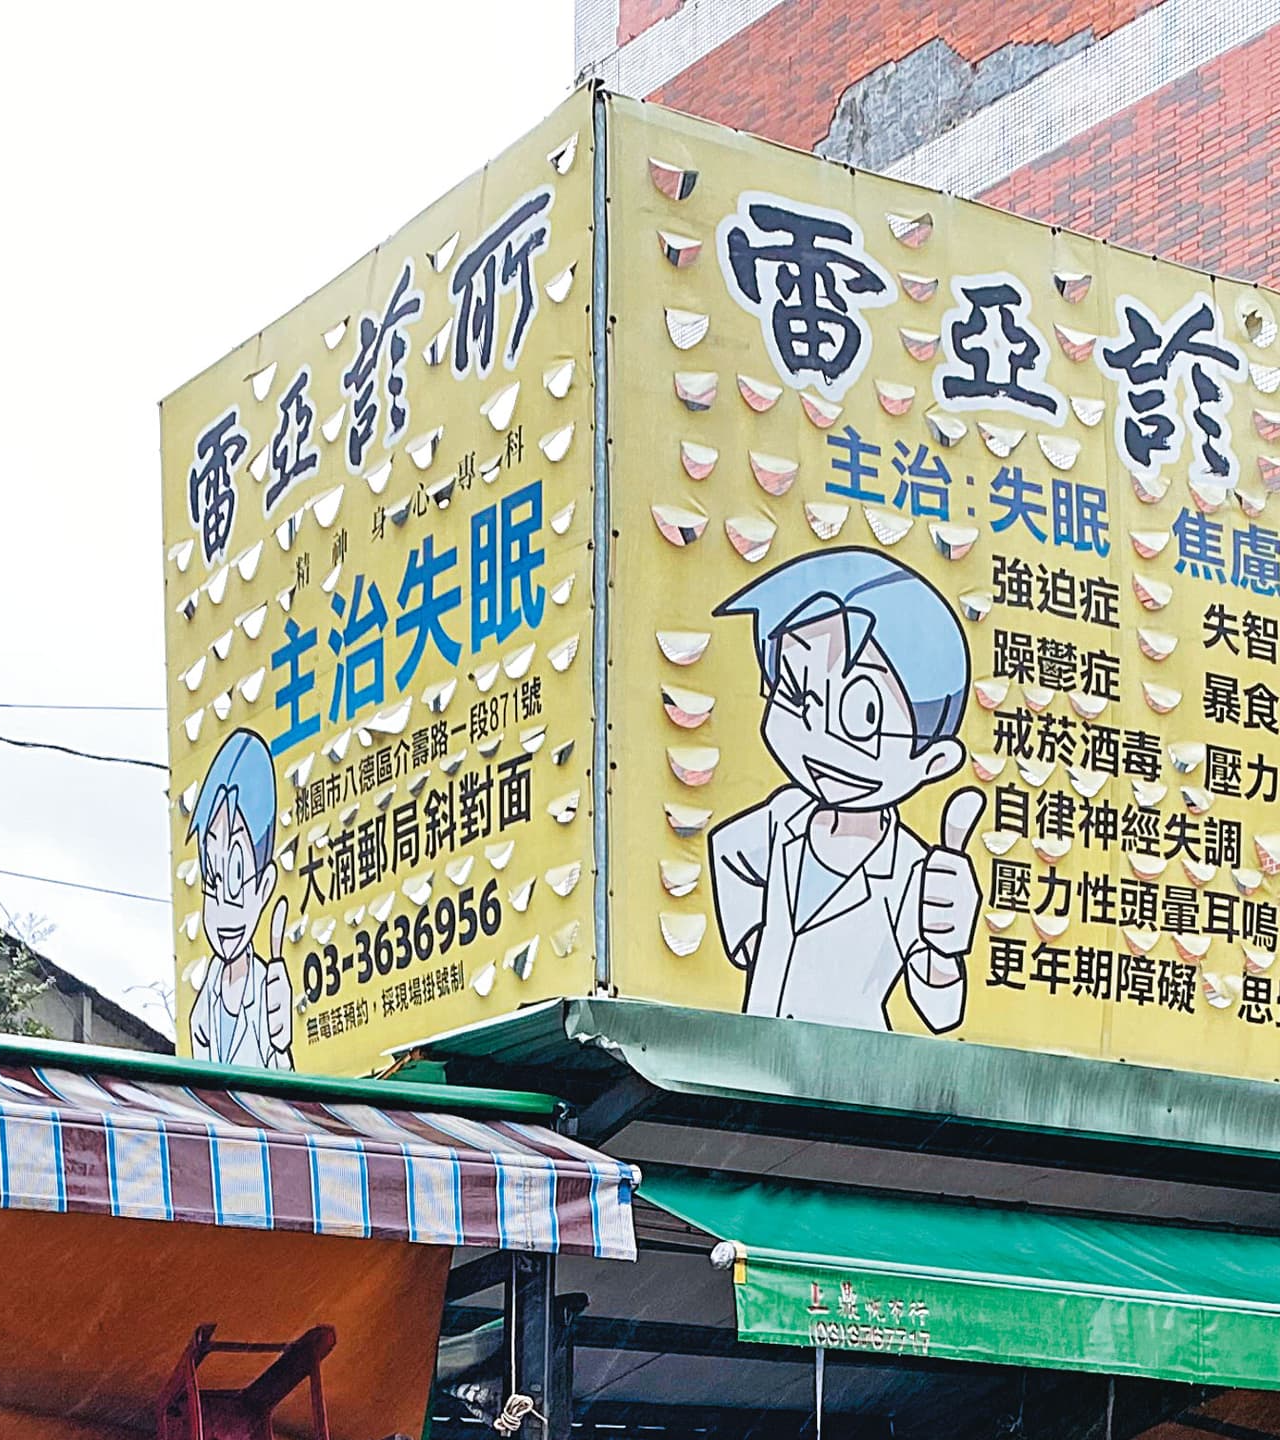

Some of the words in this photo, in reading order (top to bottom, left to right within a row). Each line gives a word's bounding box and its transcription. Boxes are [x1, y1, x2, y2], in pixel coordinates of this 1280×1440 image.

[190, 192, 551, 562] 雷亞診所
[271, 480, 546, 755] 主治失眠
[991, 557, 1120, 631] 強迫症
[1203, 604, 1279, 665] 失智
[992, 630, 1121, 702] 躁鬱症
[1203, 672, 1280, 734] 暴食
[296, 678, 543, 825] 桃園市八德區介壽路一段871號
[992, 710, 1162, 782] 戒菸酒毒
[1204, 743, 1279, 803] 壓力
[299, 753, 535, 915] 大湳郵局斜對面
[992, 785, 1242, 869] 自律神經失調
[302, 878, 503, 1003] 03-3636956
[989, 860, 1279, 951] 壓力性頭暈耳鳴
[985, 936, 1197, 1014] 更年期障礙
